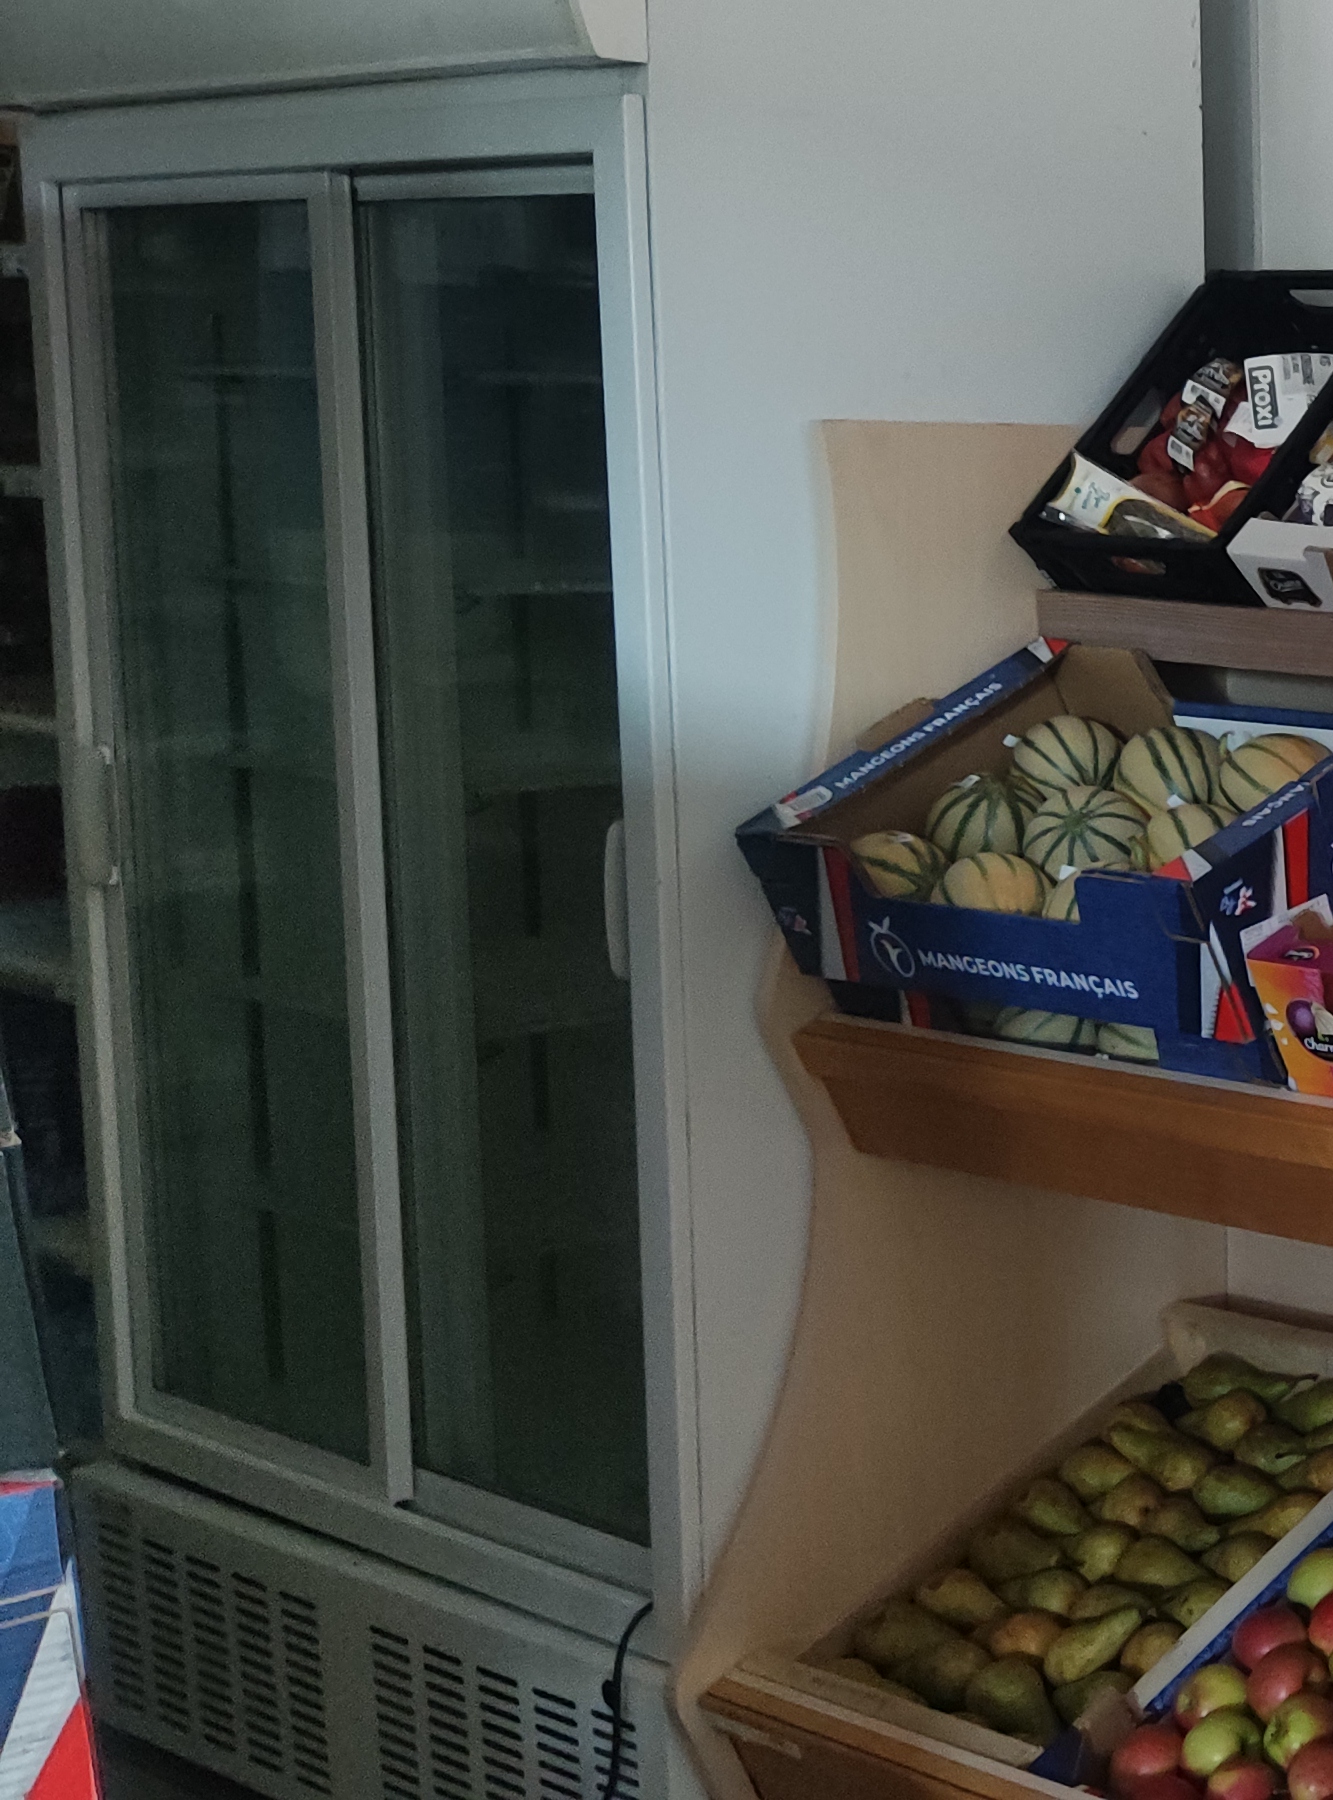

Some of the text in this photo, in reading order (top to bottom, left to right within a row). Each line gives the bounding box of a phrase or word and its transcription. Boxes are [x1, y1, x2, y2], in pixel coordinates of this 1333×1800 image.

[834, 681, 1003, 790] MANGEONS FRANÇAIS
[916, 948, 1140, 1000] MANGEONS FRANÇAIS
